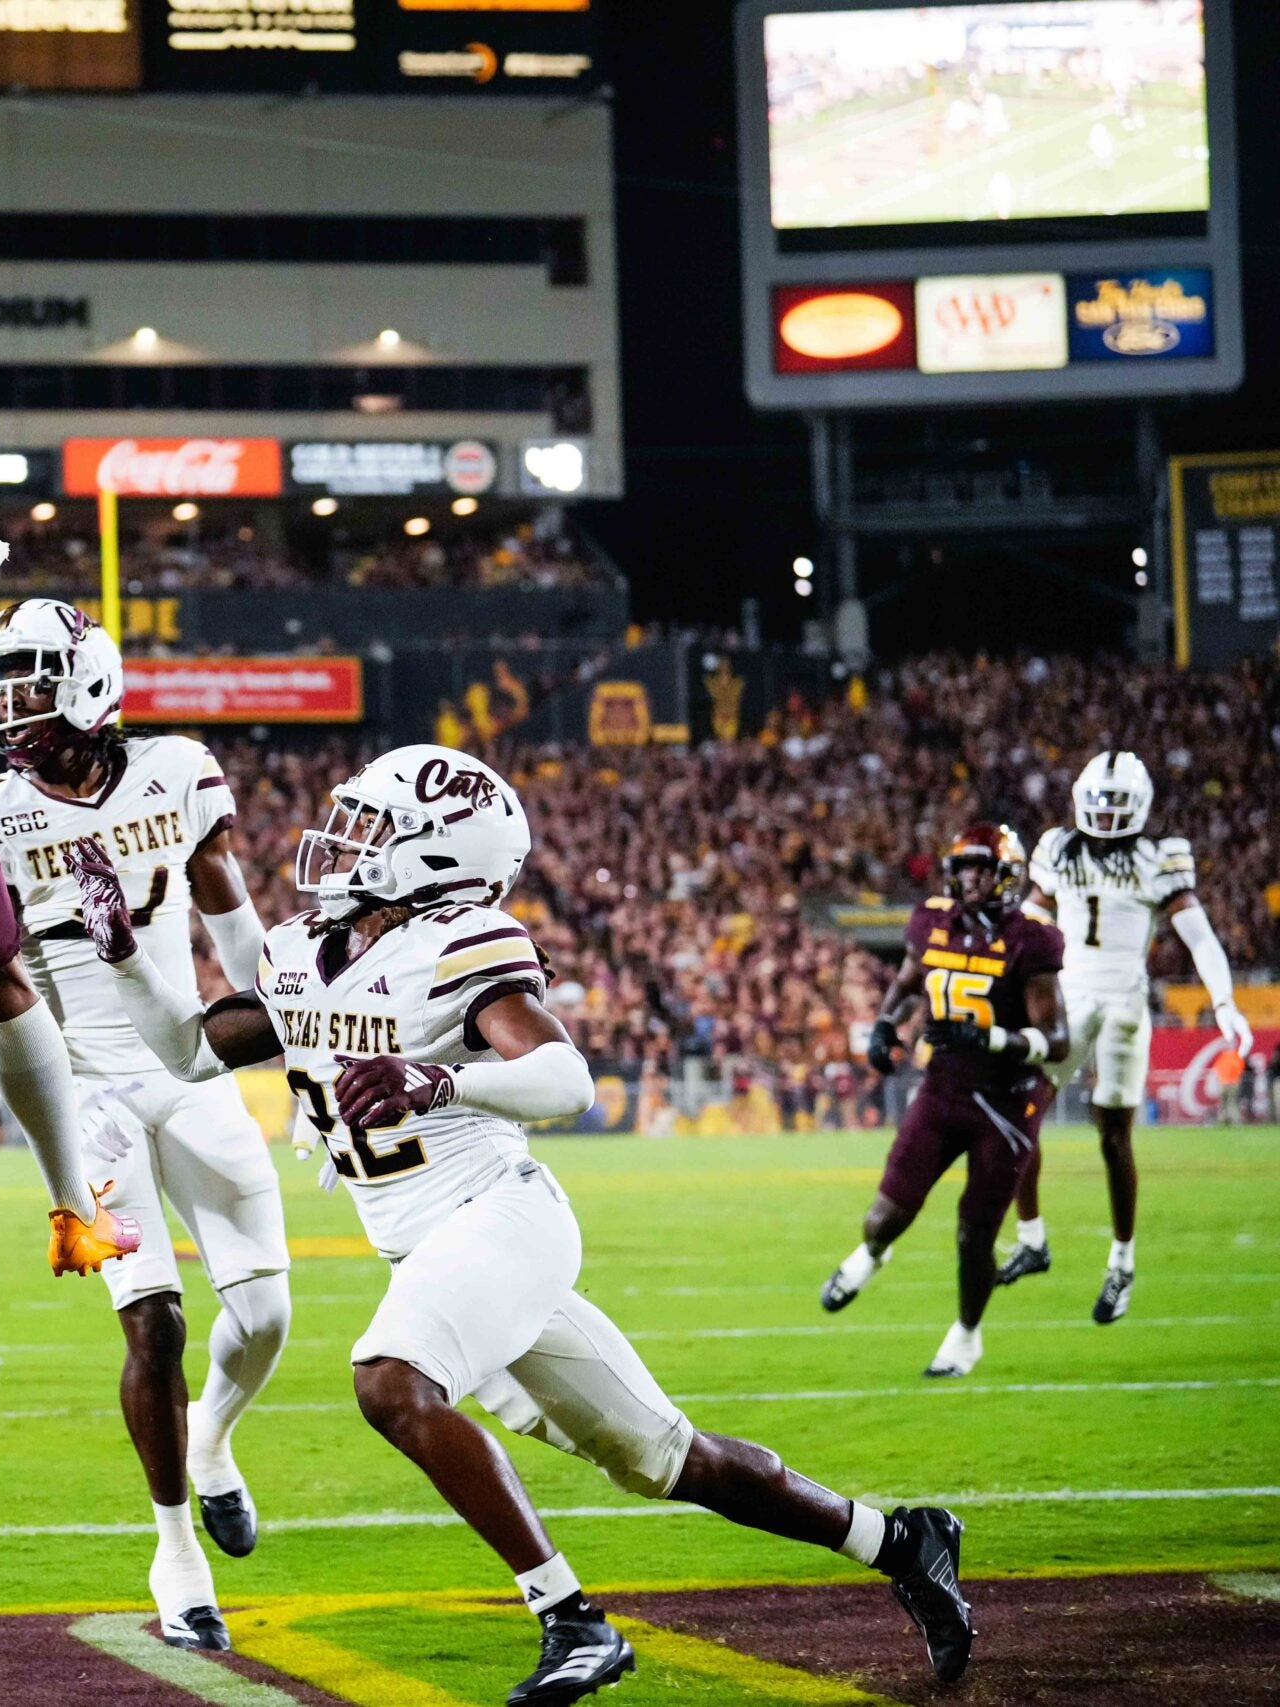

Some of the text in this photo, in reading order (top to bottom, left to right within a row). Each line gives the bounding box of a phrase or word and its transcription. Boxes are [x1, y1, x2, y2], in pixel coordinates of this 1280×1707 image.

[415, 759, 498, 811] Cats
[1, 810, 48, 836] SBC
[112, 811, 184, 857] STATE
[274, 972, 308, 995] SBC
[925, 968, 995, 1029] 15
[328, 1013, 402, 1054] STATE
